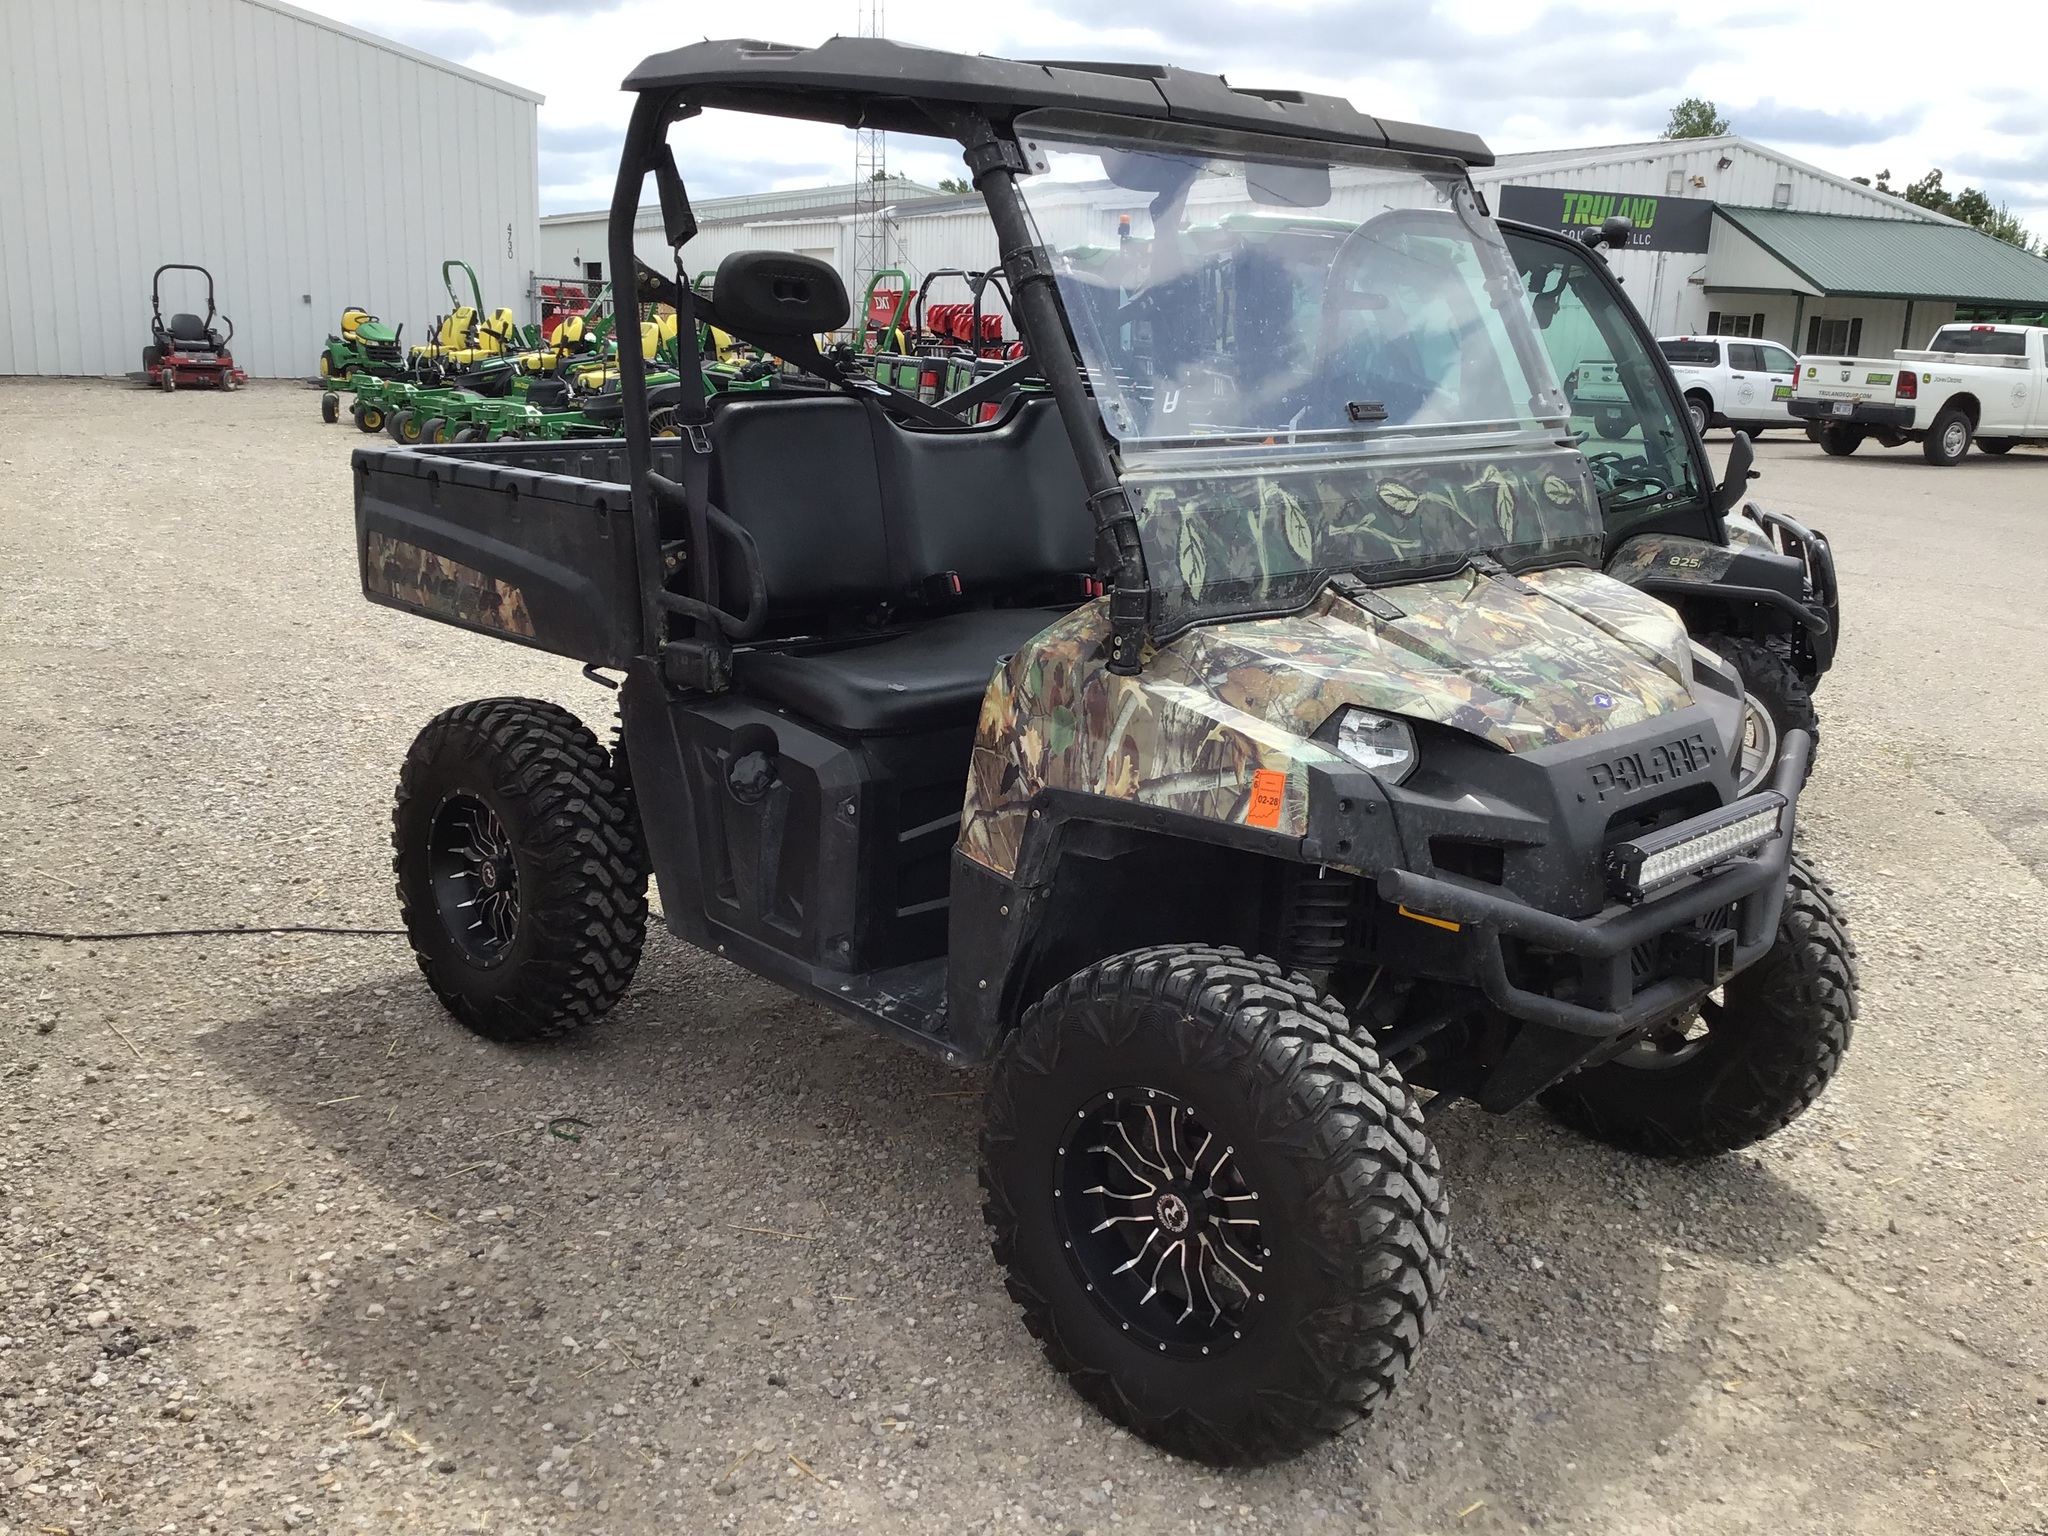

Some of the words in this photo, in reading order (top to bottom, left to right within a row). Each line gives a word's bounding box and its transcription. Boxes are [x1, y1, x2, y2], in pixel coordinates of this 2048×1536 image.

[1561, 193, 1658, 229] TRULAND
[1633, 233, 1652, 245] LLC
[1586, 734, 1711, 803] POLARIS
[1257, 795, 1279, 806] 02-28
